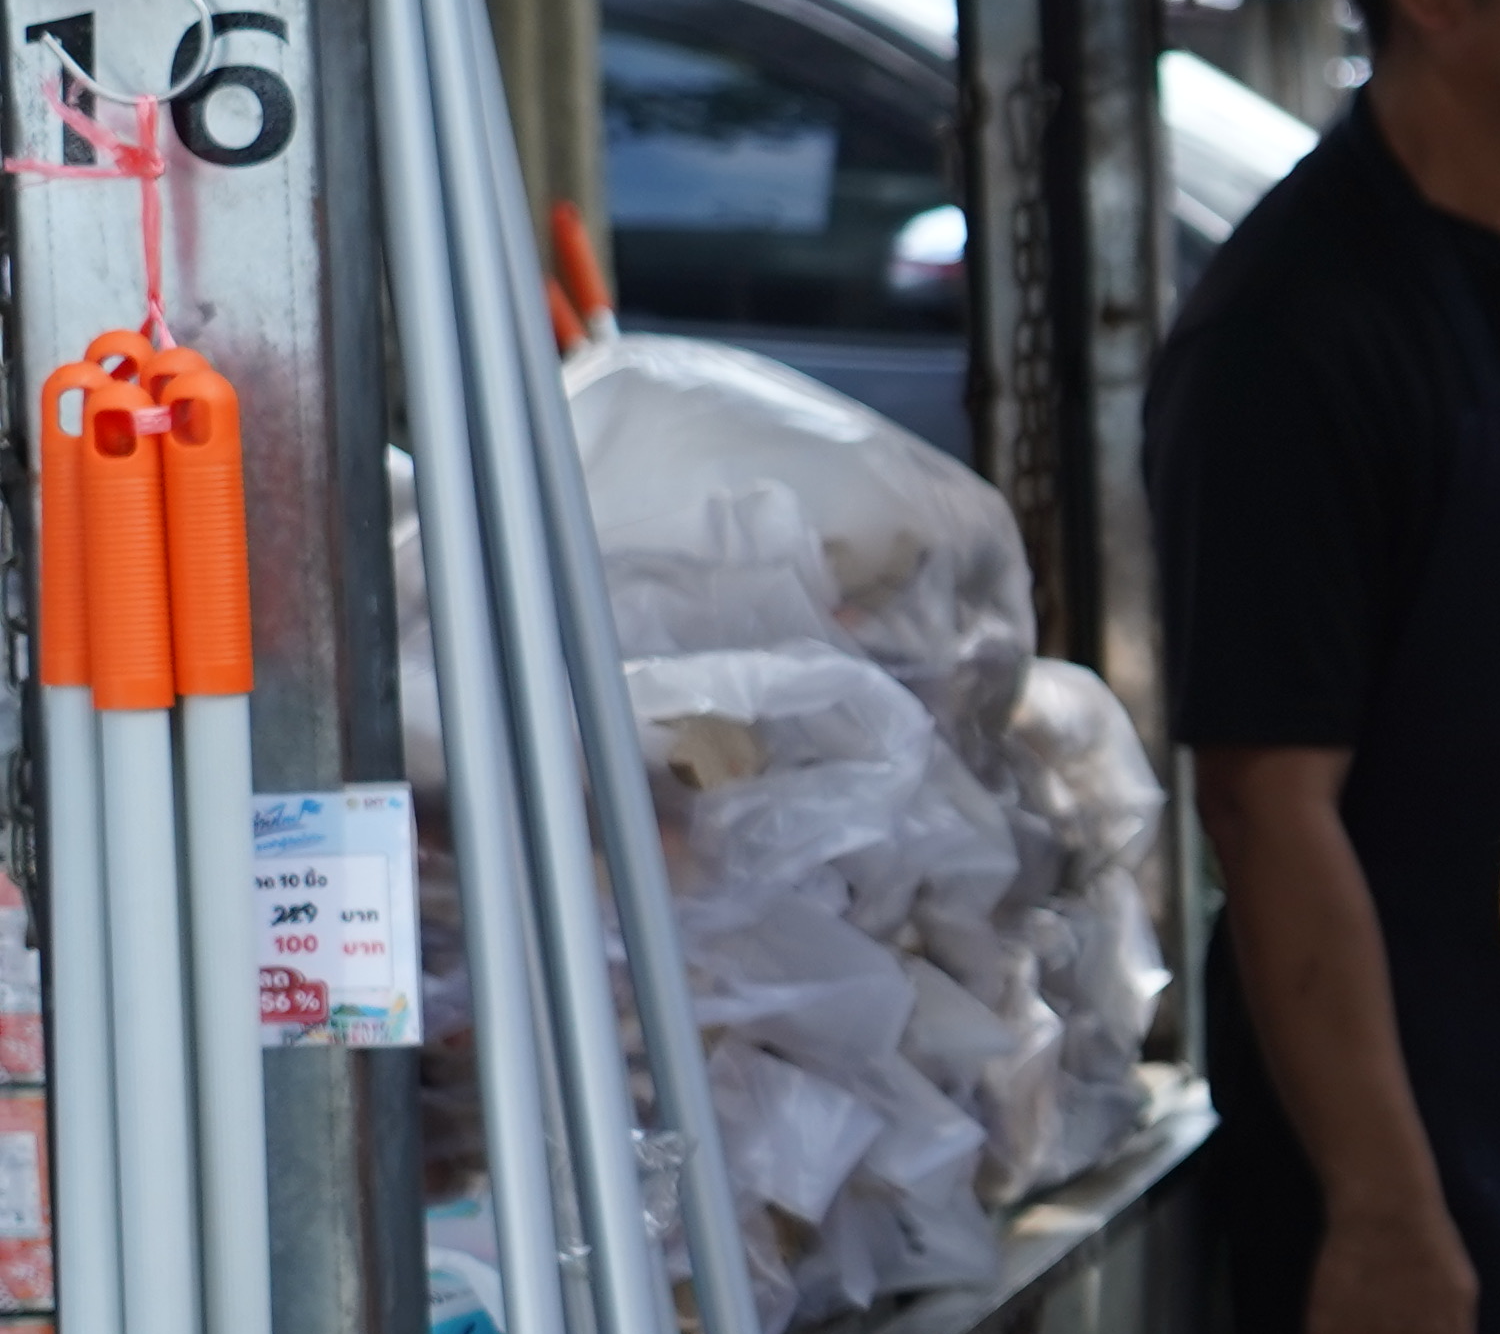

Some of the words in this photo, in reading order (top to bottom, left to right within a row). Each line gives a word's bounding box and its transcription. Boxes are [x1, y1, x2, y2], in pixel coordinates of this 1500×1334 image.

[26, 11, 297, 168] 16
[340, 909, 380, 924] บาท
[274, 933, 319, 955] 100
[342, 939, 386, 957] บาท
